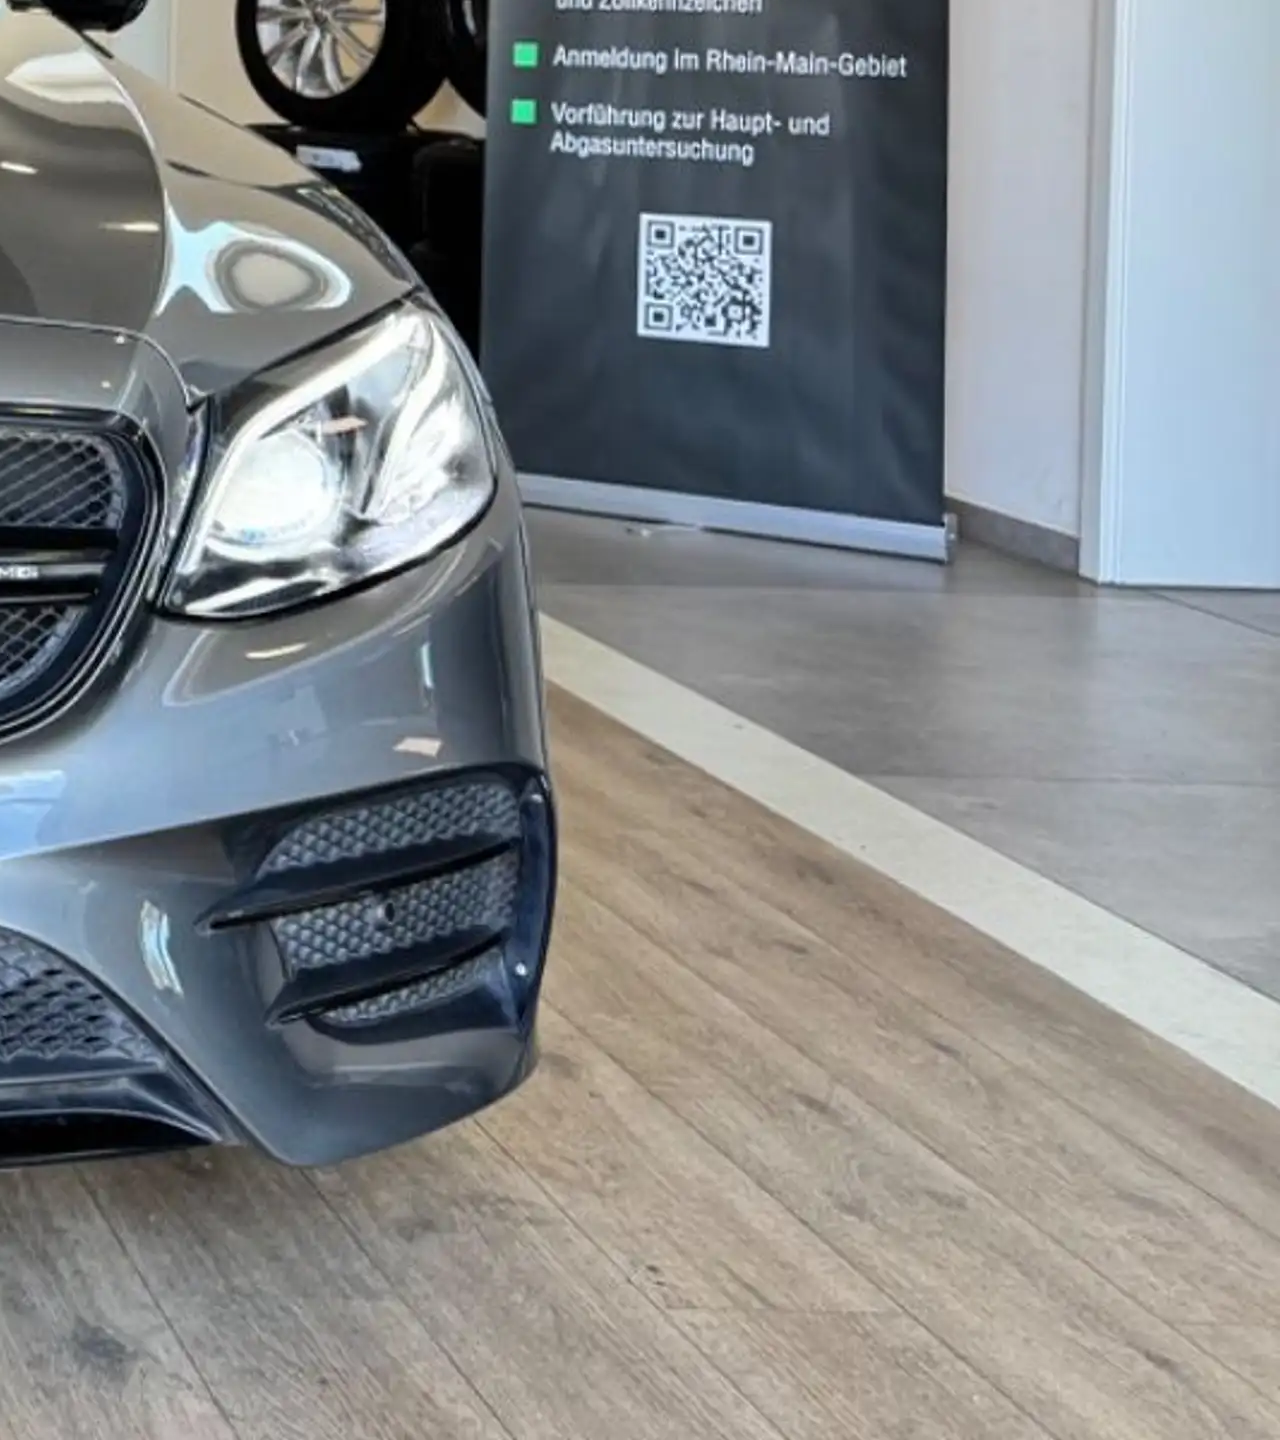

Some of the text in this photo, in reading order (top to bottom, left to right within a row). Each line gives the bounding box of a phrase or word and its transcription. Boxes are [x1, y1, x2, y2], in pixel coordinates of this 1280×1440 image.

[553, 45, 907, 78] Anmeldung im Rhein-Main-Gebiet
[551, 101, 830, 136] Vorführung zur Haupt- und
[550, 131, 754, 165] Abgasuntersuchung
